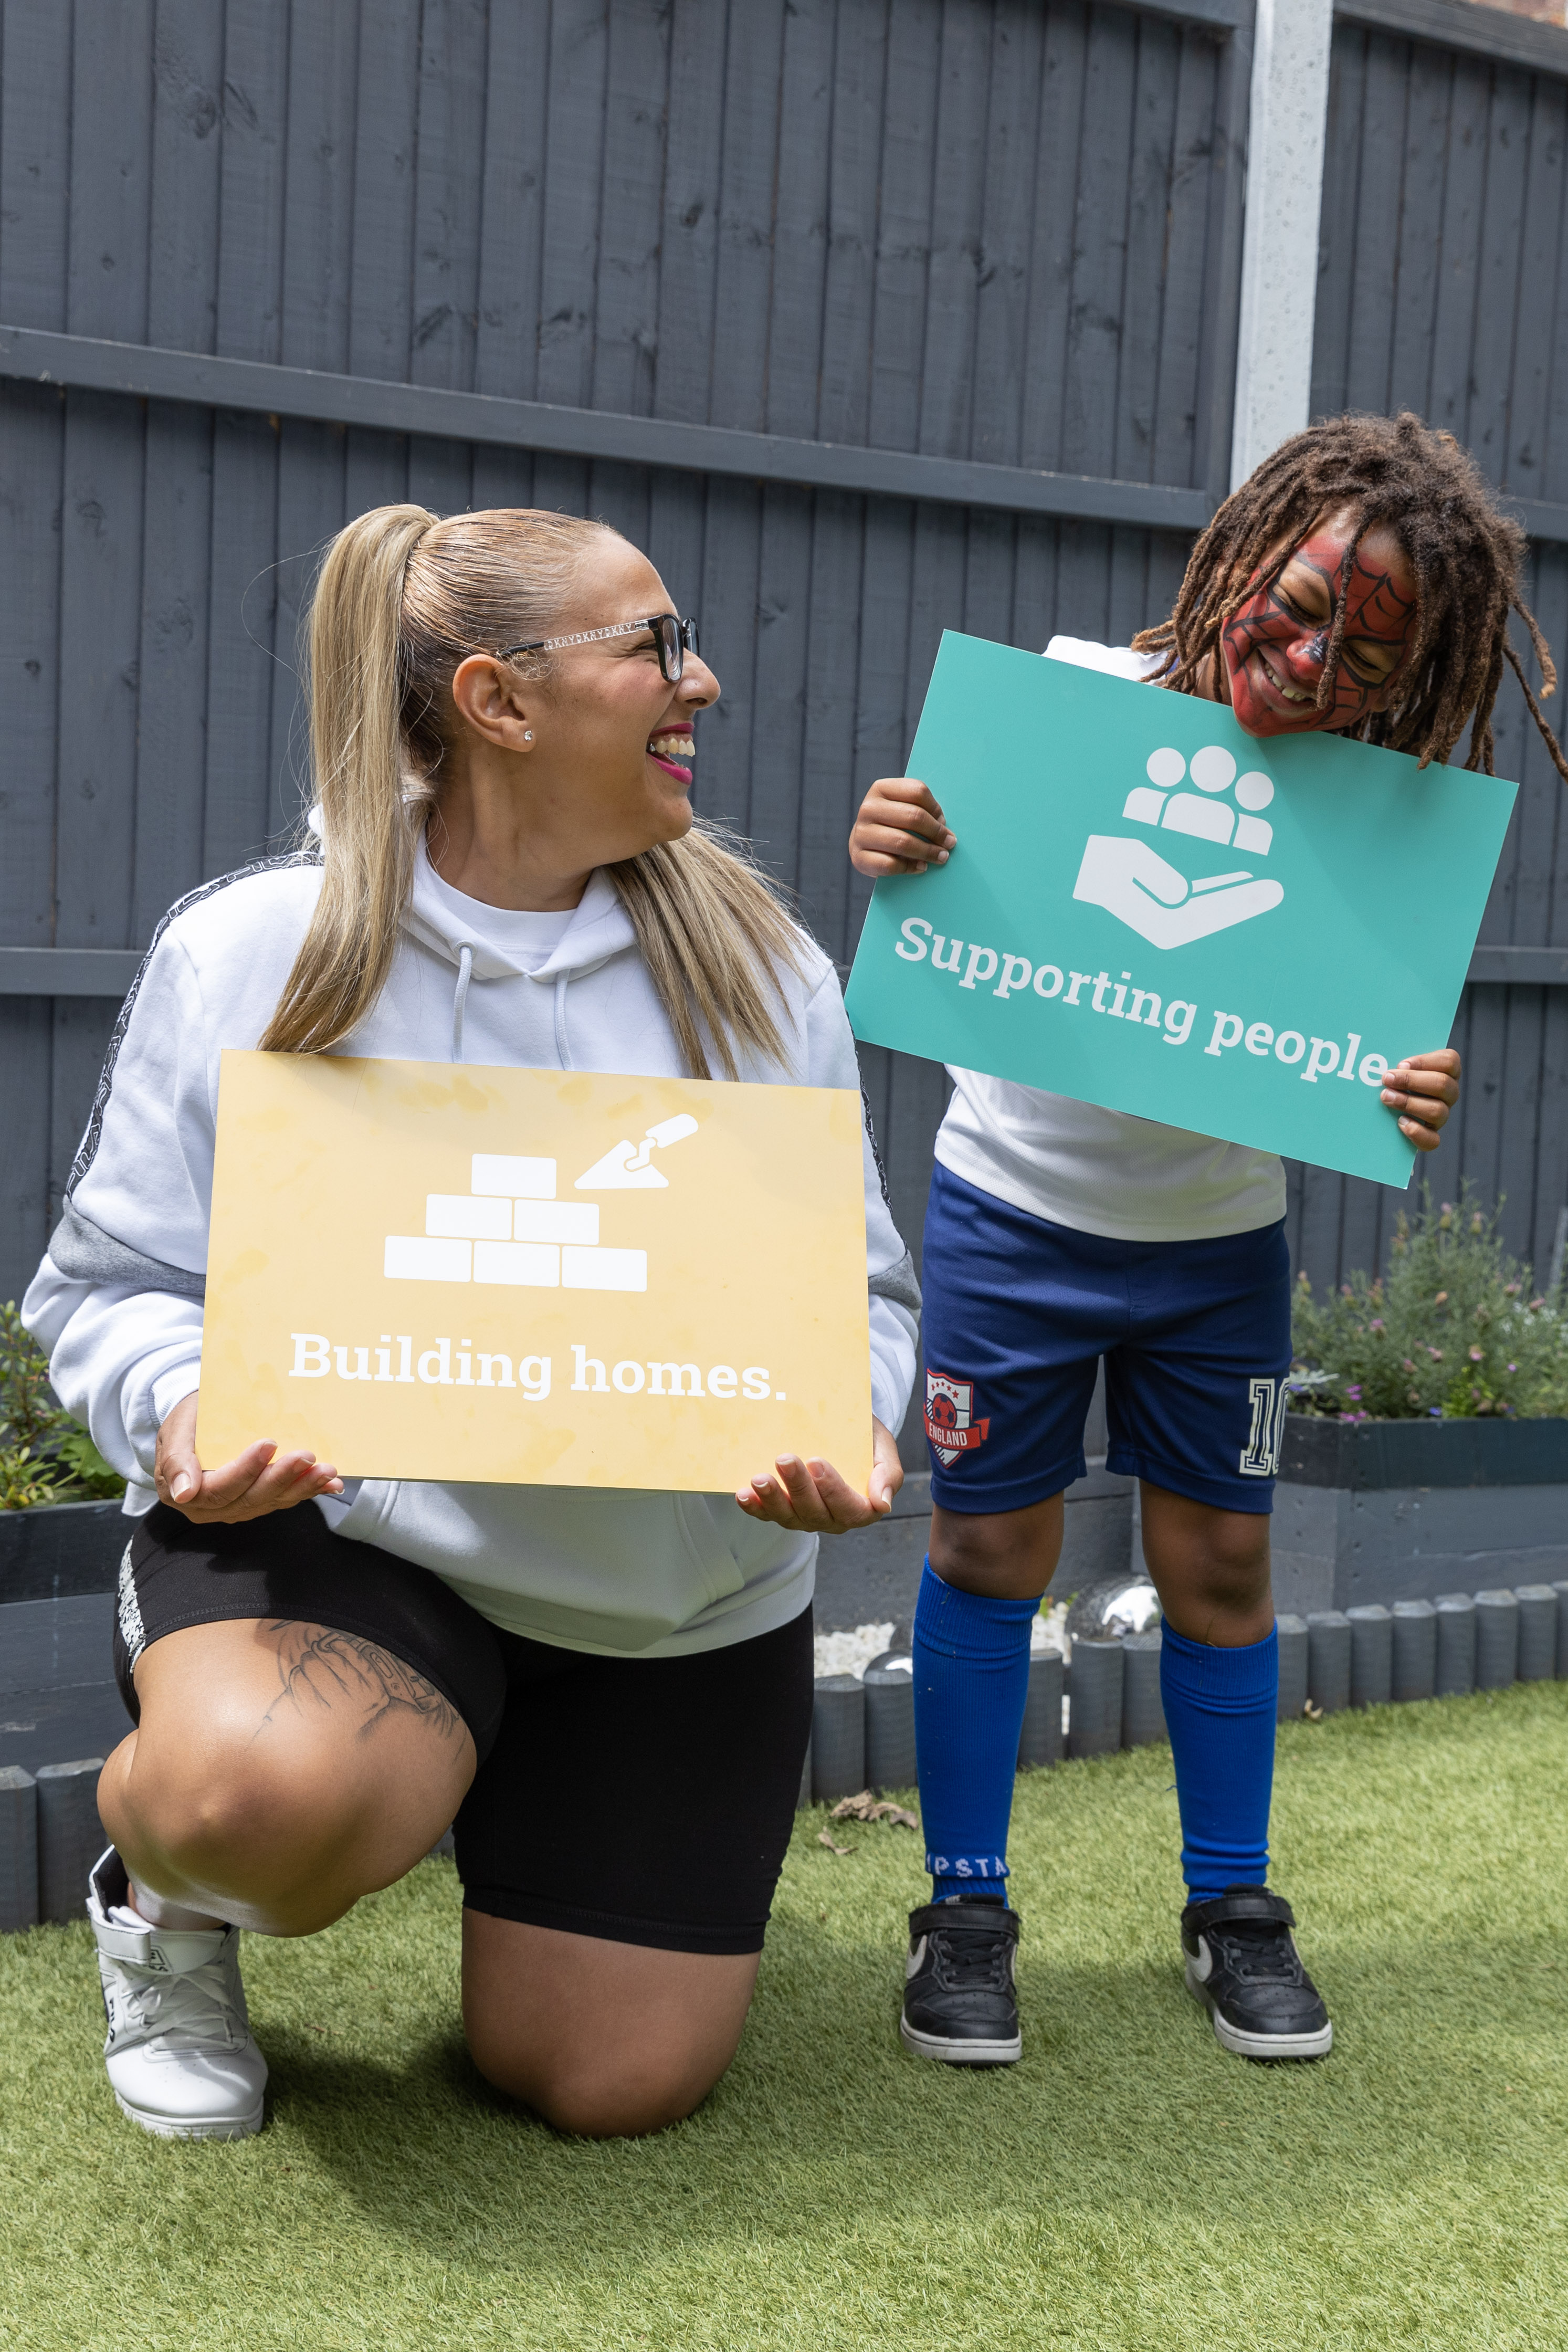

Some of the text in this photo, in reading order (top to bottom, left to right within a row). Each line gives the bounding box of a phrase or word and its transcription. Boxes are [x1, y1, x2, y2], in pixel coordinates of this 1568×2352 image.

[895, 917, 1387, 1088] Supporting people
[288, 1332, 786, 1402] Building homes.
[929, 1422, 967, 1446] ENGLAND
